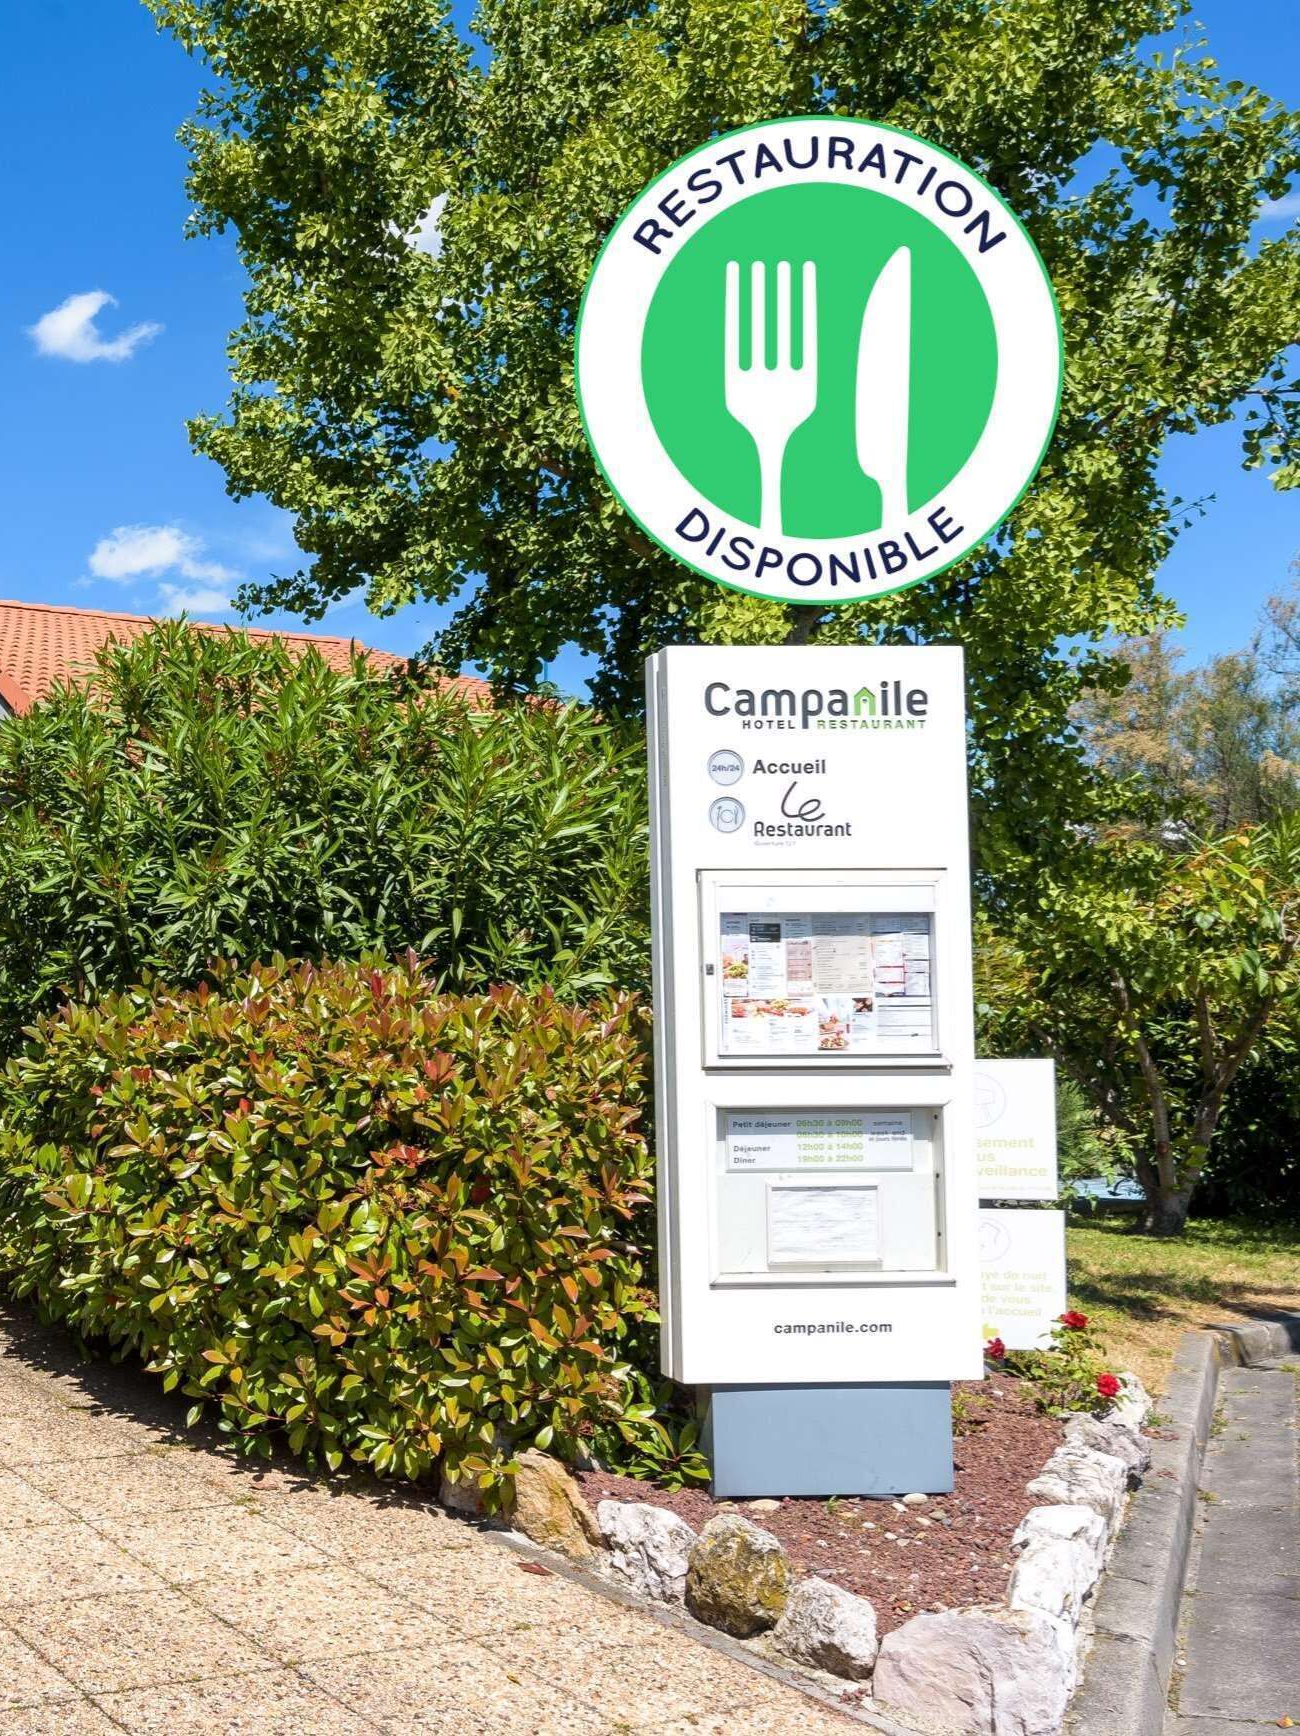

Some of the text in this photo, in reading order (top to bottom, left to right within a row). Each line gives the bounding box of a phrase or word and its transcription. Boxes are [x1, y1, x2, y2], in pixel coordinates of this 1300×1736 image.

[704, 681, 928, 729] Campanile
[742, 719, 927, 730] HOTEL RESTAURANT
[752, 759, 827, 774] Accueil
[781, 780, 826, 822] Le
[753, 821, 853, 838] Restaurant
[773, 1321, 894, 1336] campanile.com
